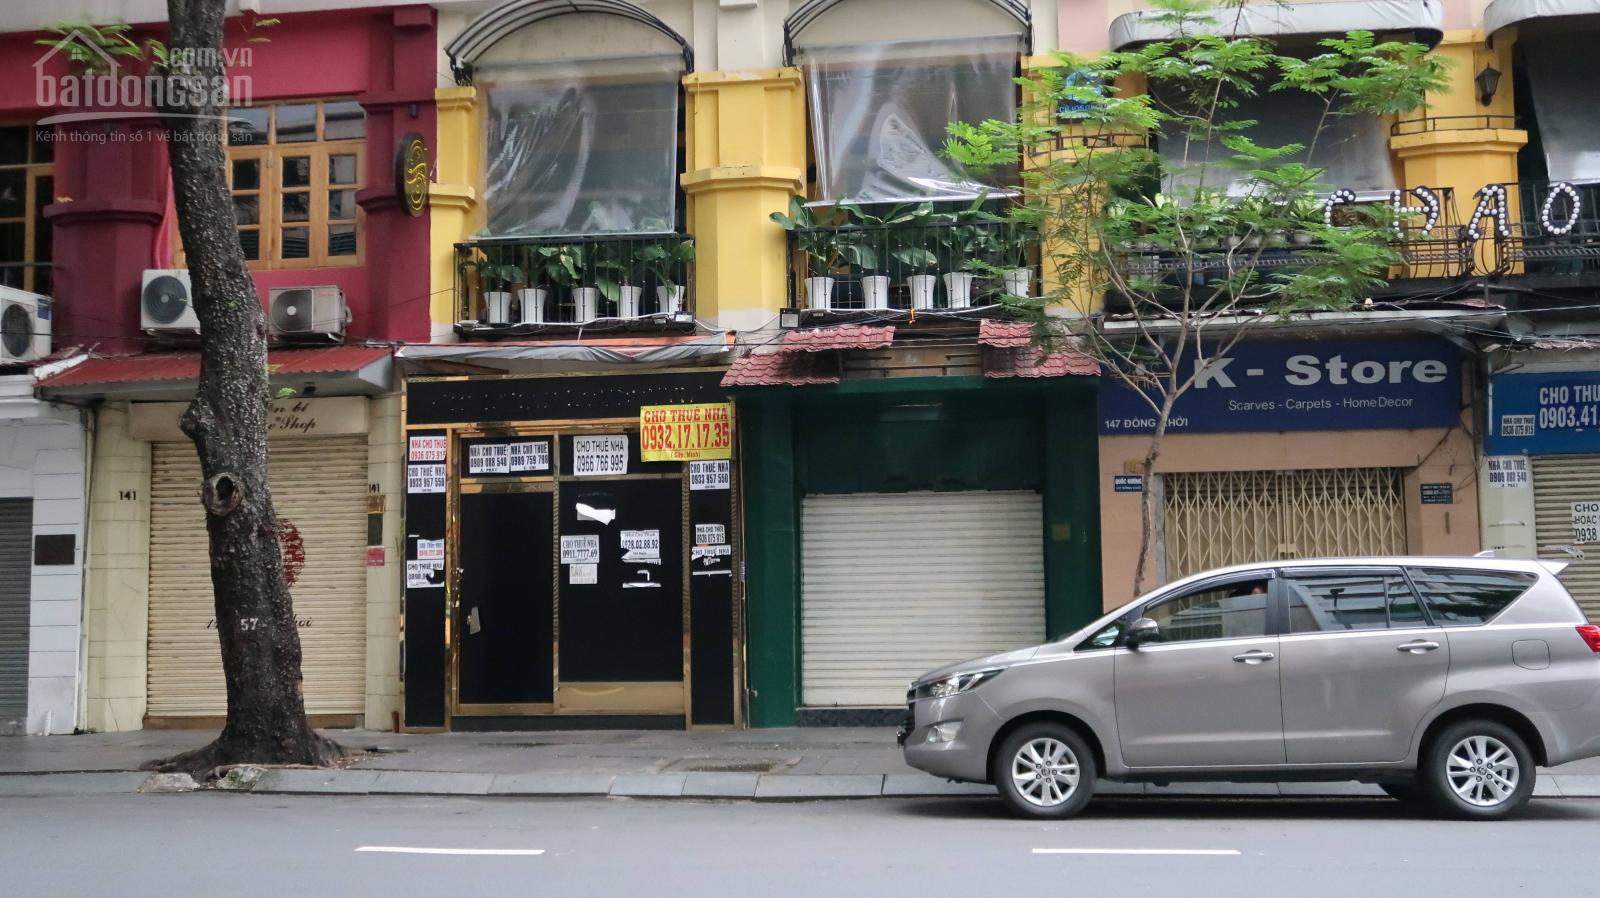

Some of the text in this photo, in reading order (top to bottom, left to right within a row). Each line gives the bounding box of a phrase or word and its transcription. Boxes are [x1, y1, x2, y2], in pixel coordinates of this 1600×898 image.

[1194, 358, 1236, 388] K
[1285, 354, 1448, 386] Store
[1540, 386, 1569, 405] CHO
[1229, 400, 1275, 410] Scarves
[1285, 399, 1332, 412] Carpets
[644, 410, 666, 423] CHO
[280, 415, 316, 433] Shop
[1105, 420, 1121, 429] 147
[642, 423, 730, 449] 0932.17.17.35
[576, 441, 590, 453] CHO
[577, 454, 624, 472] 0966 766 995
[691, 463, 701, 474] CHO
[409, 467, 419, 477] CHO
[691, 474, 705, 485] 0933
[706, 474, 717, 484] 957
[119, 490, 137, 501] 141
[1574, 504, 1599, 512] CHO
[1575, 527, 1597, 541] 0938
[563, 540, 574, 549] CHO
[241, 617, 259, 631] 57
